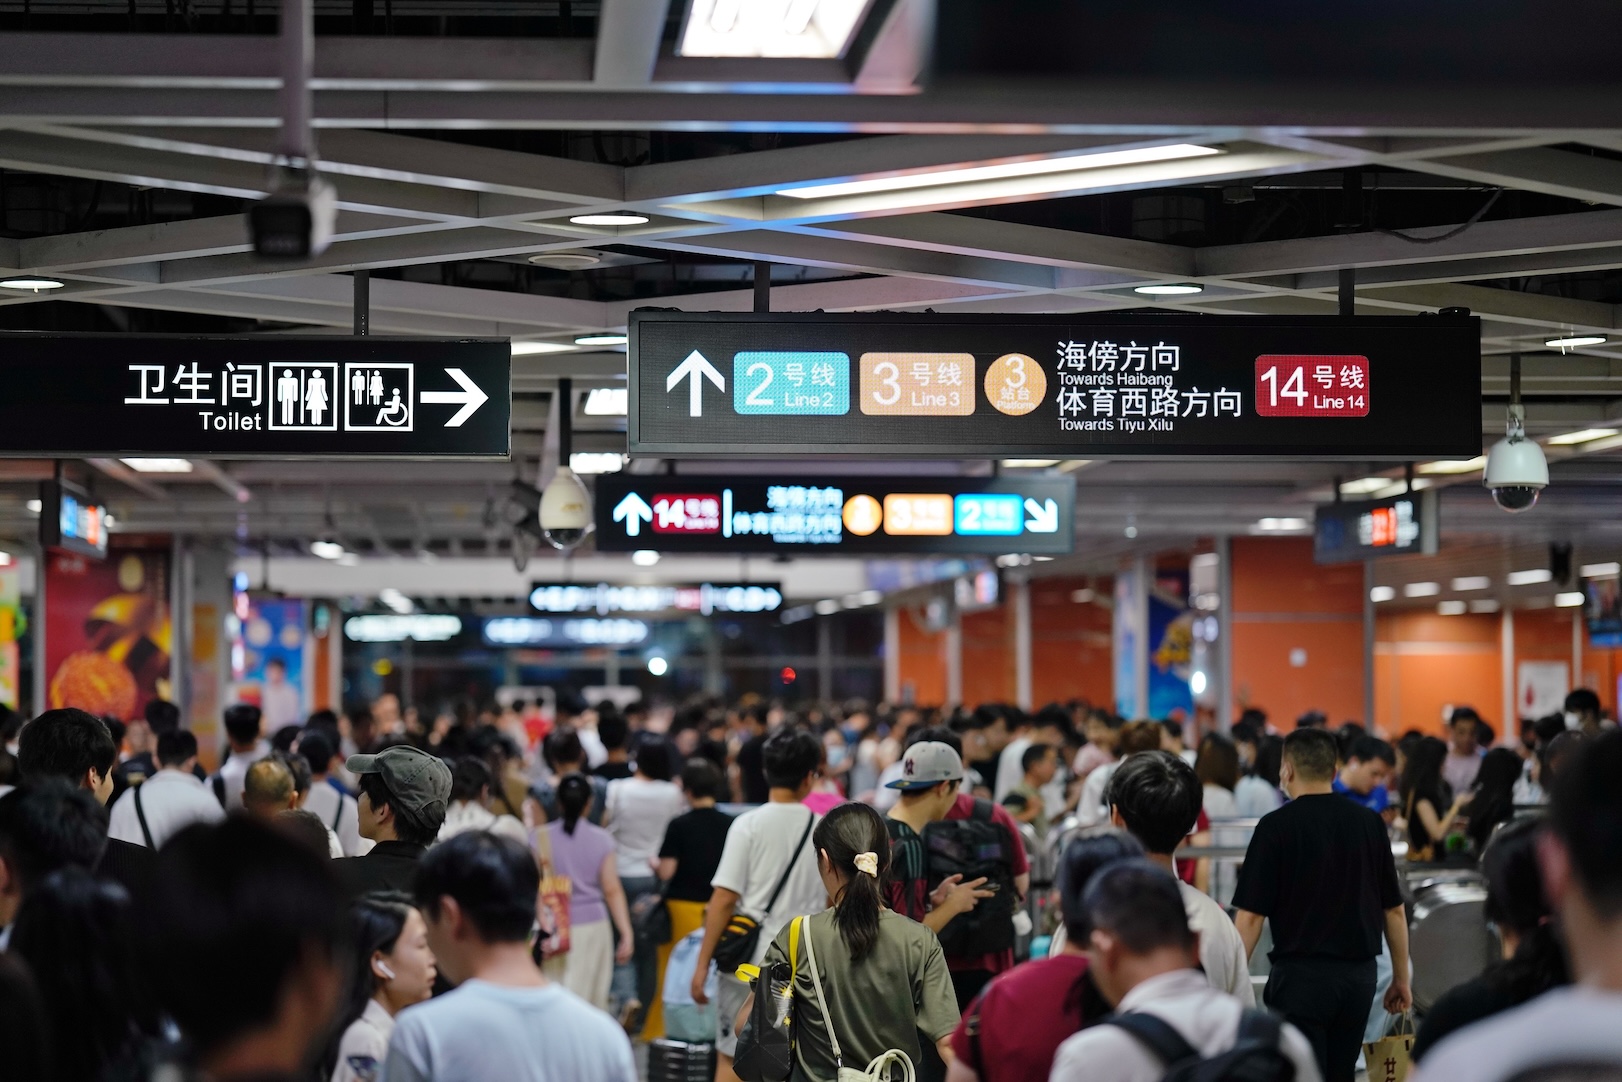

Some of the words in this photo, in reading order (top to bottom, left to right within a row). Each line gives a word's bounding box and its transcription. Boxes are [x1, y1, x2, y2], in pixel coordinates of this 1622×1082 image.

[1056, 340, 1180, 372] 海傍方向
[124, 361, 263, 407] 卫生间
[744, 361, 775, 406] 2
[783, 362, 836, 388] 号线
[872, 361, 901, 406] 3
[909, 362, 963, 387] 号线
[1005, 356, 1027, 388] 3
[1057, 371, 1114, 386] Towards
[1117, 371, 1174, 387] Haibang
[1260, 365, 1309, 407] 14
[1312, 364, 1365, 390] 号线
[784, 391, 821, 408] Line
[822, 392, 834, 408] 2
[911, 391, 947, 407] Line
[949, 391, 961, 407] 3
[1056, 386, 1242, 418] 体育西路方向
[1313, 395, 1345, 410] Line
[1346, 395, 1365, 410] 14
[198, 411, 262, 431] Toilet
[1057, 417, 1114, 431] Towards
[1117, 417, 1145, 434] Tiyu
[1147, 417, 1174, 431] Xilu
[653, 498, 685, 529] 14
[890, 499, 913, 530] 3
[959, 500, 983, 529] 2
